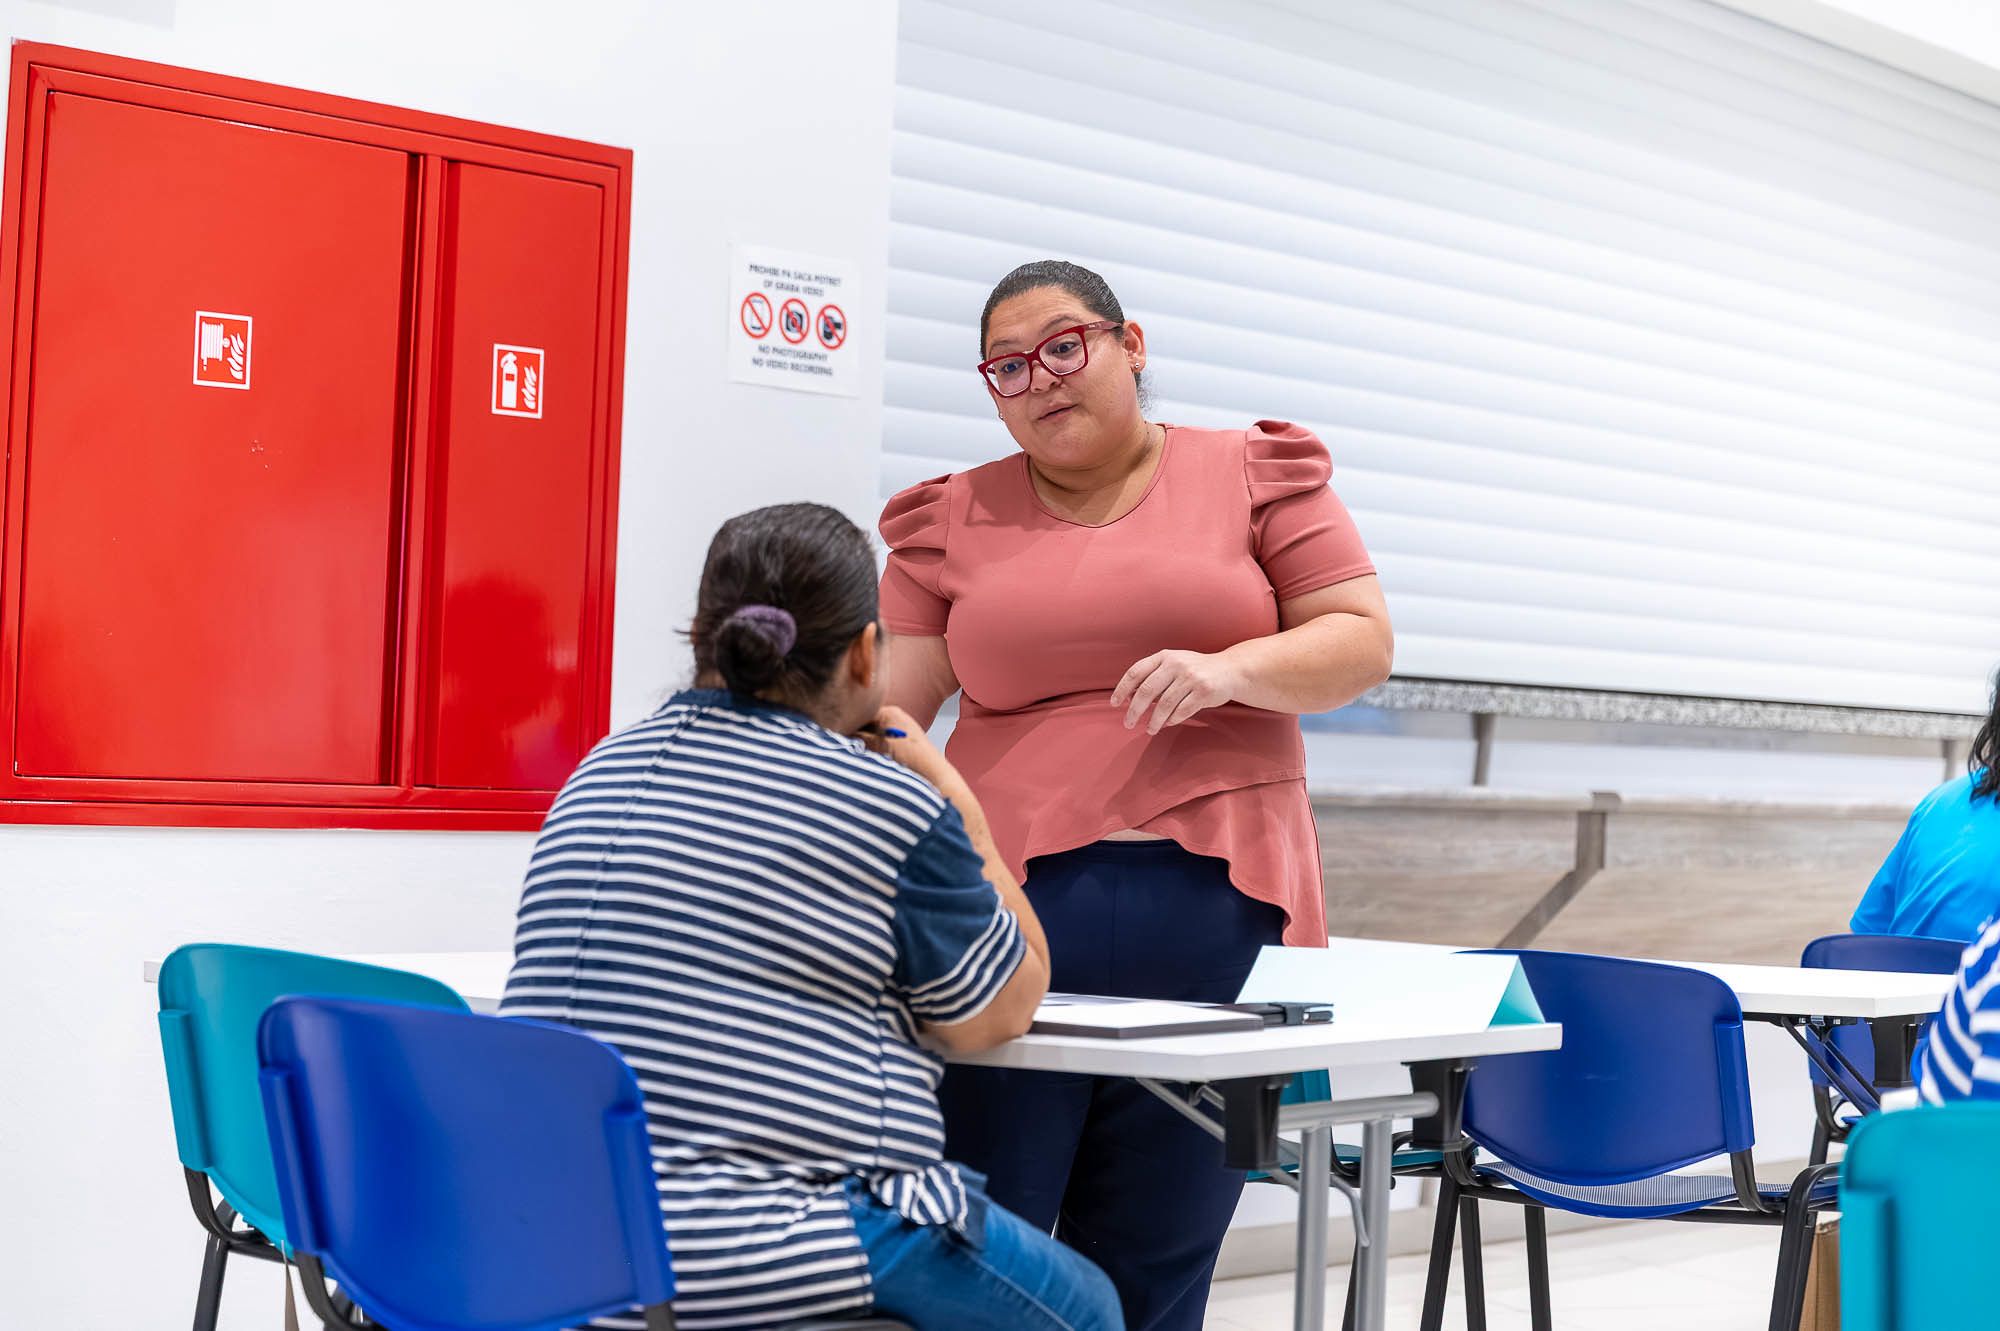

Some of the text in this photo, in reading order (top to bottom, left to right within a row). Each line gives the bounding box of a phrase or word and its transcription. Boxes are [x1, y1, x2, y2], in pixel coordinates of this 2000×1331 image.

[758, 344, 828, 361] NO PHOTOGRAPHY
[752, 357, 833, 376] NO VIDEO RECORDING
